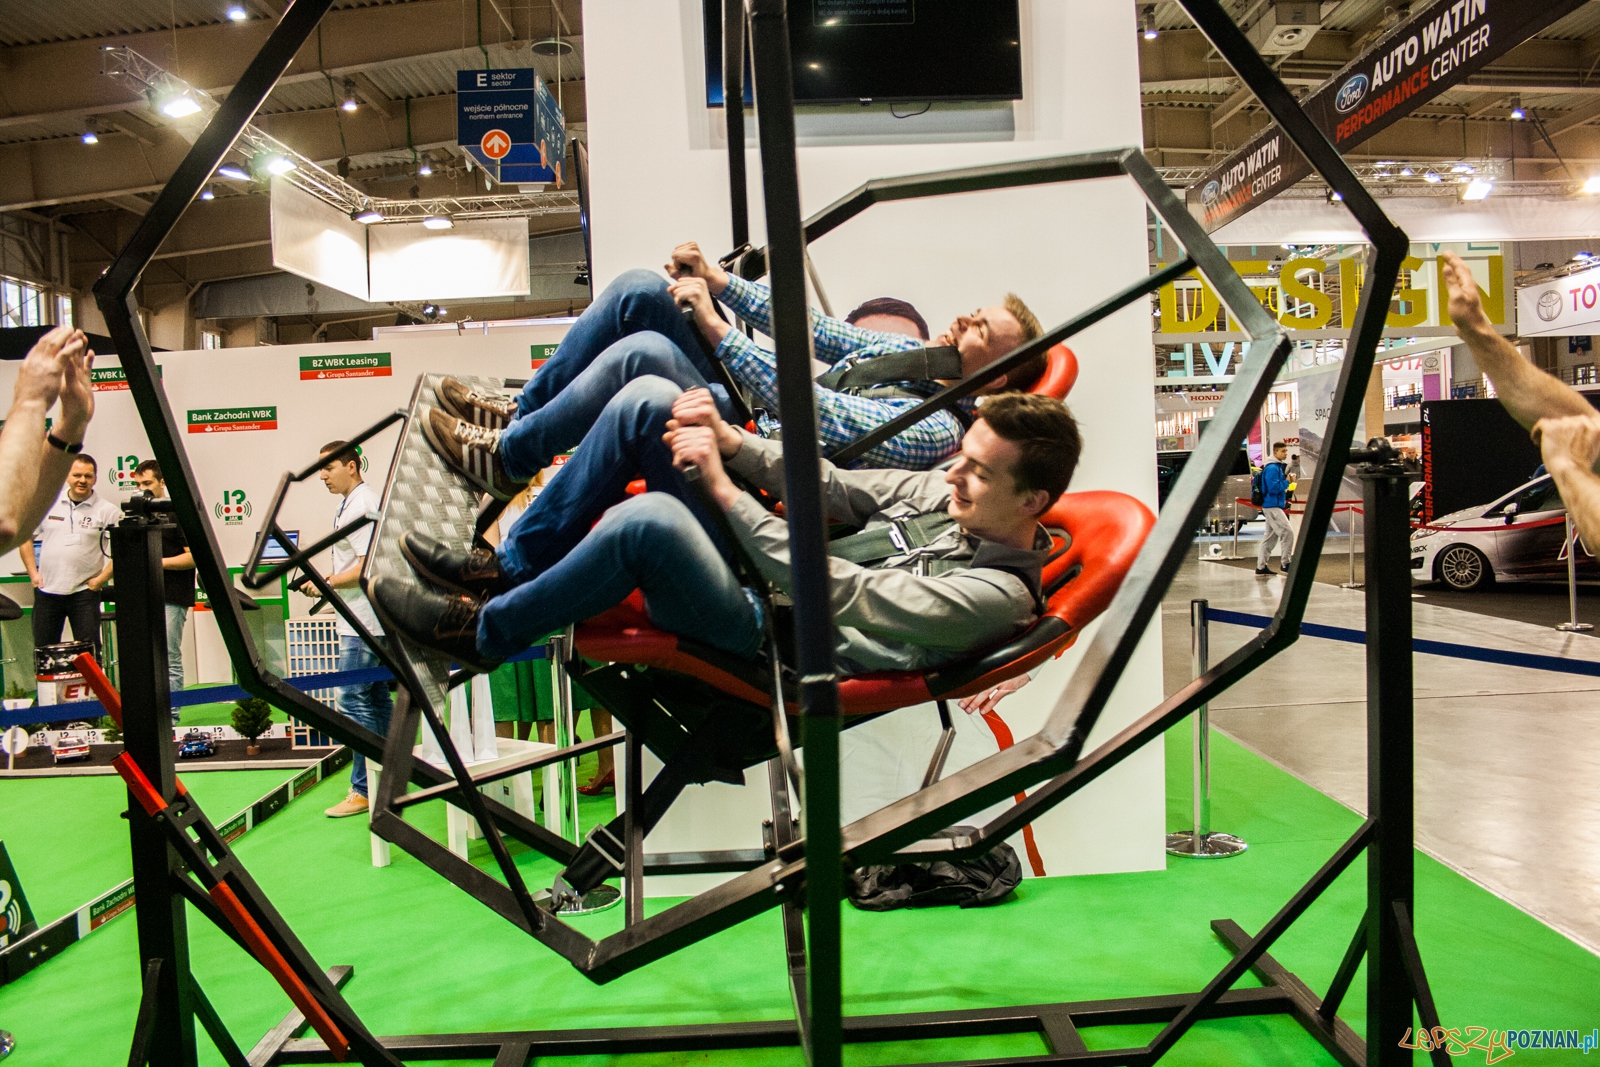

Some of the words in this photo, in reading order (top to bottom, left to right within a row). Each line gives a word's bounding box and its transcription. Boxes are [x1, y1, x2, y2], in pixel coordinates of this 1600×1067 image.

[1371, 35, 1419, 92] AUTO
[1423, 0, 1487, 55] WATIN
[477, 73, 487, 87] E
[1336, 64, 1429, 144] PERFORMANCE
[1431, 24, 1490, 81] CENTER
[1340, 82, 1363, 109] Ford
[464, 104, 492, 114] wejście
[494, 103, 529, 113] północne
[1221, 161, 1246, 195] AUTO
[1247, 136, 1279, 177] WATIN
[1252, 165, 1282, 197] CENTER
[1570, 283, 1600, 312] TO
[544, 348, 555, 356] BZ
[312, 359, 323, 368] BZ
[325, 358, 345, 367] WBK
[346, 357, 378, 367] Leasing
[98, 371, 118, 379] WBK
[346, 370, 375, 378] Santander
[192, 413, 212, 421] Bank
[213, 411, 250, 420] Zachodni
[251, 410, 272, 418] WBK
[233, 423, 261, 431] Santander
[92, 903, 106, 916] Bank
